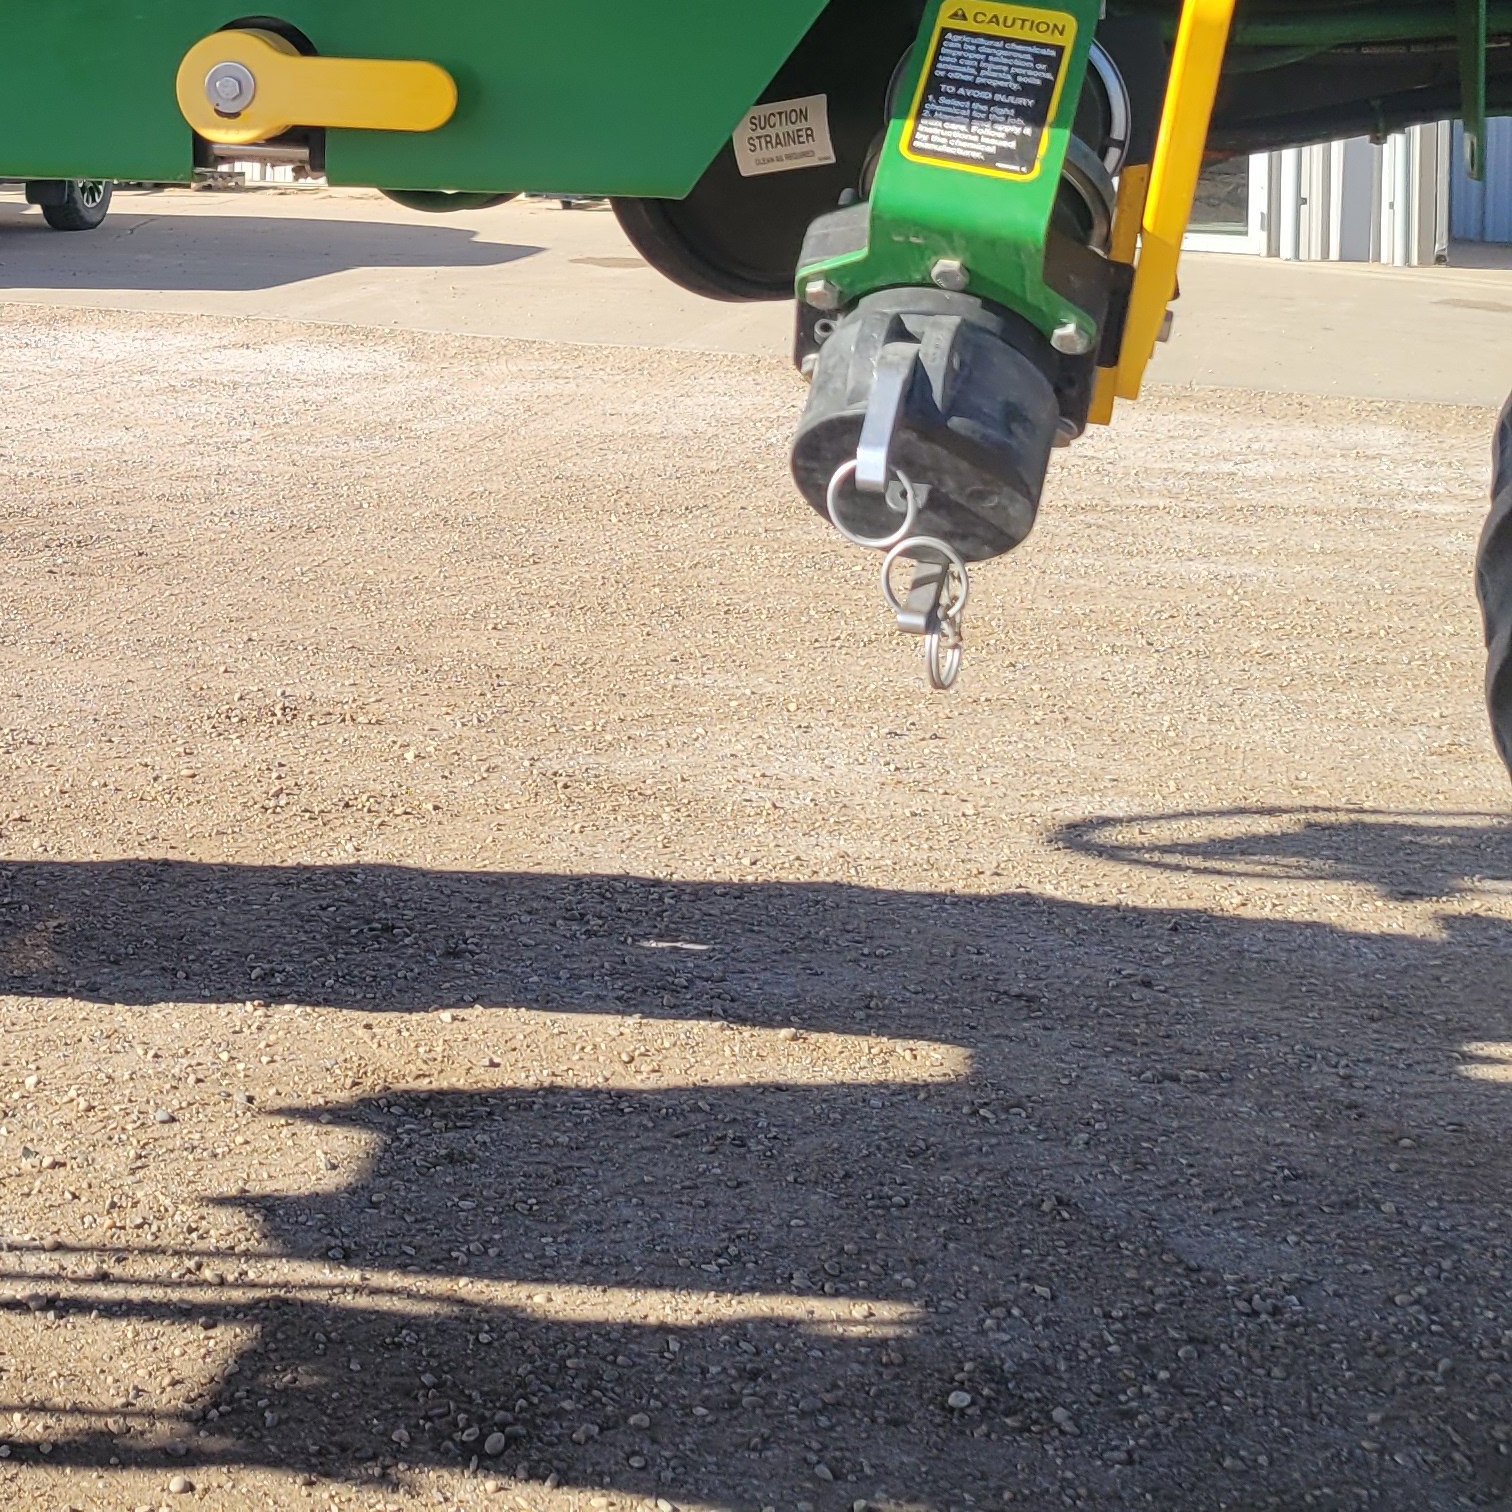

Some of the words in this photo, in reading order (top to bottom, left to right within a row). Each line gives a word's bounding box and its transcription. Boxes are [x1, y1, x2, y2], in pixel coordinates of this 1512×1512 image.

[972, 11, 1065, 37] CAUTION
[938, 84, 955, 93] TO
[956, 88, 991, 100] AVOID
[749, 106, 809, 132] SUCTION
[747, 127, 816, 153] STRAINER
